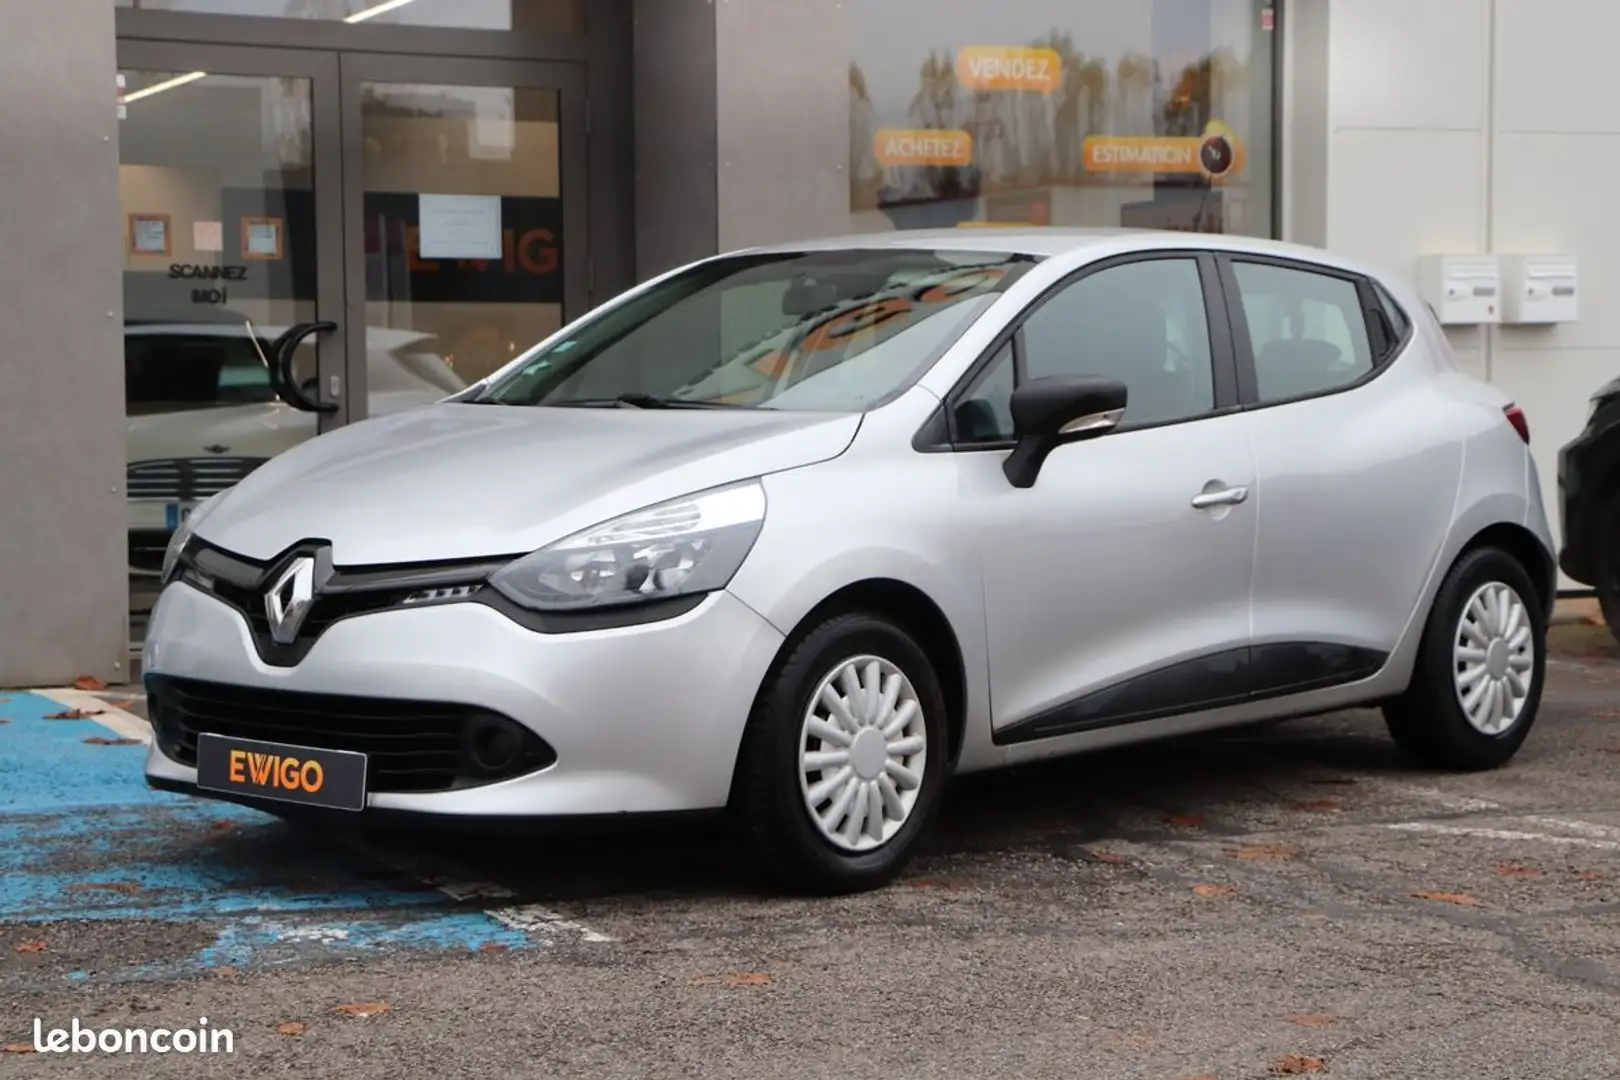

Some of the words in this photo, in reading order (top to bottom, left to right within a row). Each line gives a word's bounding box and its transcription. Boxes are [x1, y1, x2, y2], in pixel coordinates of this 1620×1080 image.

[968, 56, 1050, 81] VENDEZ
[884, 137, 964, 159] ACHETEZ
[1092, 145, 1192, 164] ESTIMATION
[405, 226, 557, 275] EIG
[168, 263, 248, 281] SCANNEZ
[229, 750, 324, 793] EWIGO
